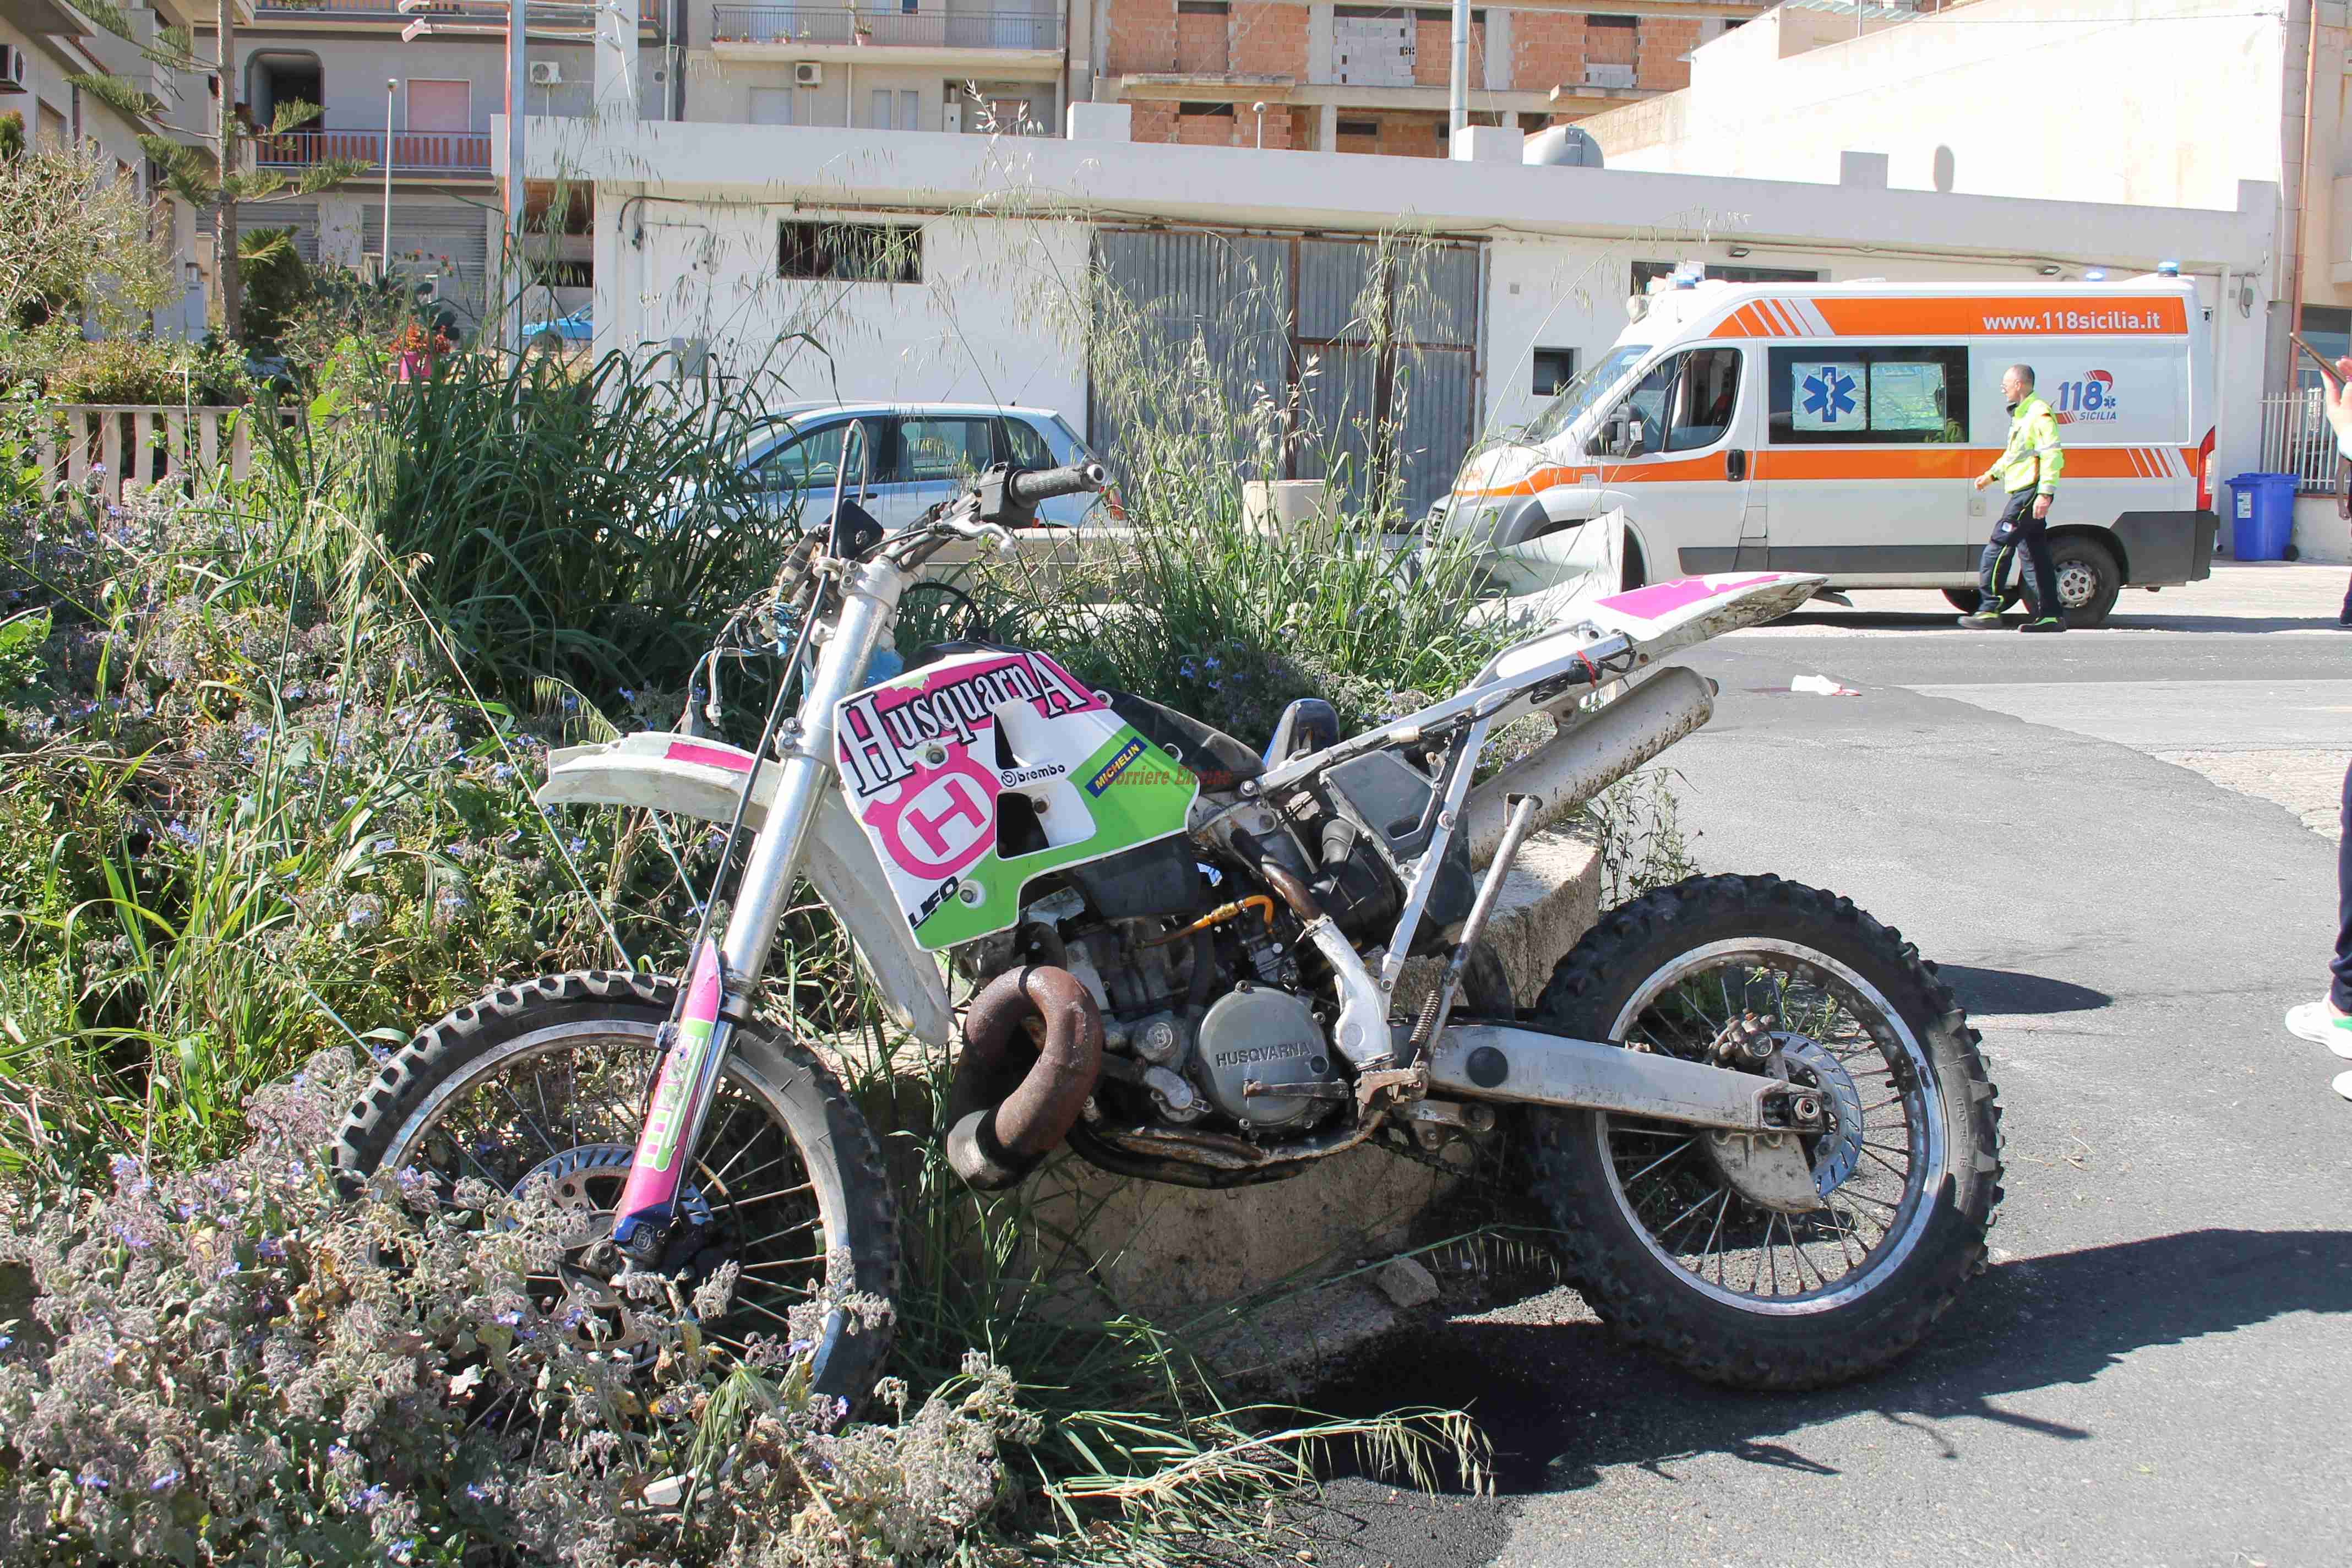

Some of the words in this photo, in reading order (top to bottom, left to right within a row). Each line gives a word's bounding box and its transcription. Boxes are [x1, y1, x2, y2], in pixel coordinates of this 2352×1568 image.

[1983, 311, 2161, 329] www.118sicilia.it
[2058, 381, 2103, 411] 118
[2079, 411, 2116, 420] SICILIA
[1016, 764, 1065, 782] brembo
[1095, 743, 1140, 790] MICHELIN
[1215, 1042, 1313, 1068] HUSQVARNA
